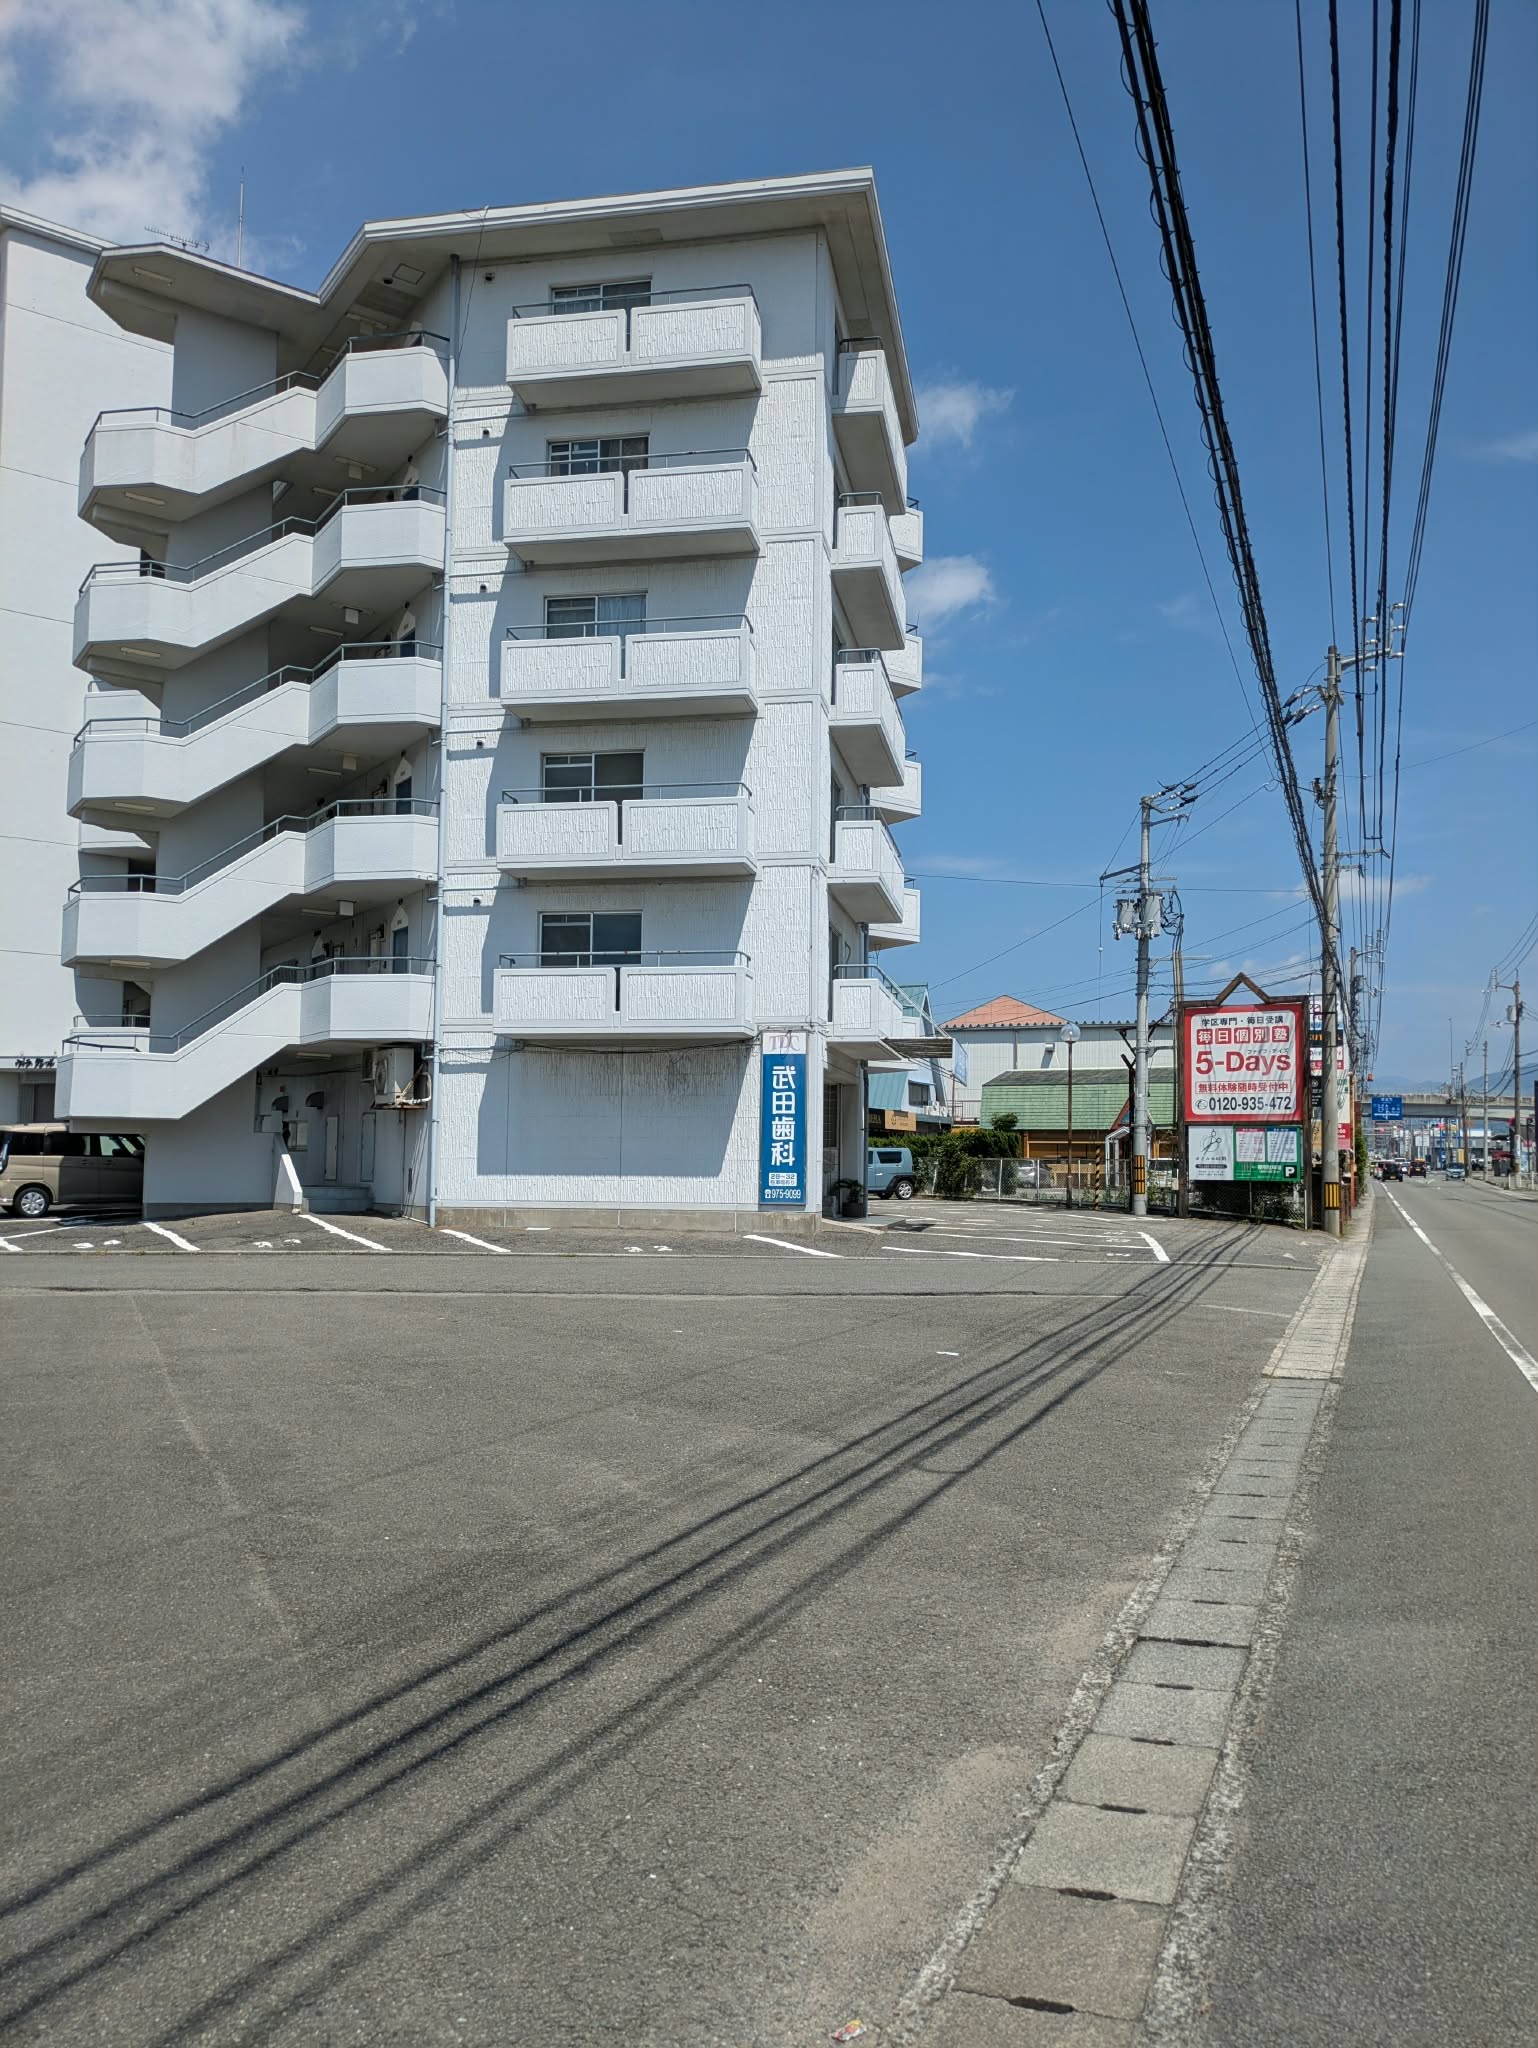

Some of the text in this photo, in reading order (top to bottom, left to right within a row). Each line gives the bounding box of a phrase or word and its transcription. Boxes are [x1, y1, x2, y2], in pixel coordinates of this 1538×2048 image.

[1201, 1015, 1284, 1026] 学区専門・毎日受講
[1198, 1027, 1288, 1043] 毎日個別塾
[1195, 1051, 1291, 1076] 5-Days
[1198, 1081, 1289, 1093] 無料体験随時受付中
[1209, 1096, 1292, 1111] 0120-935-472
[771, 1065, 796, 1167] 武田歯科
[1285, 1166, 1295, 1177] P
